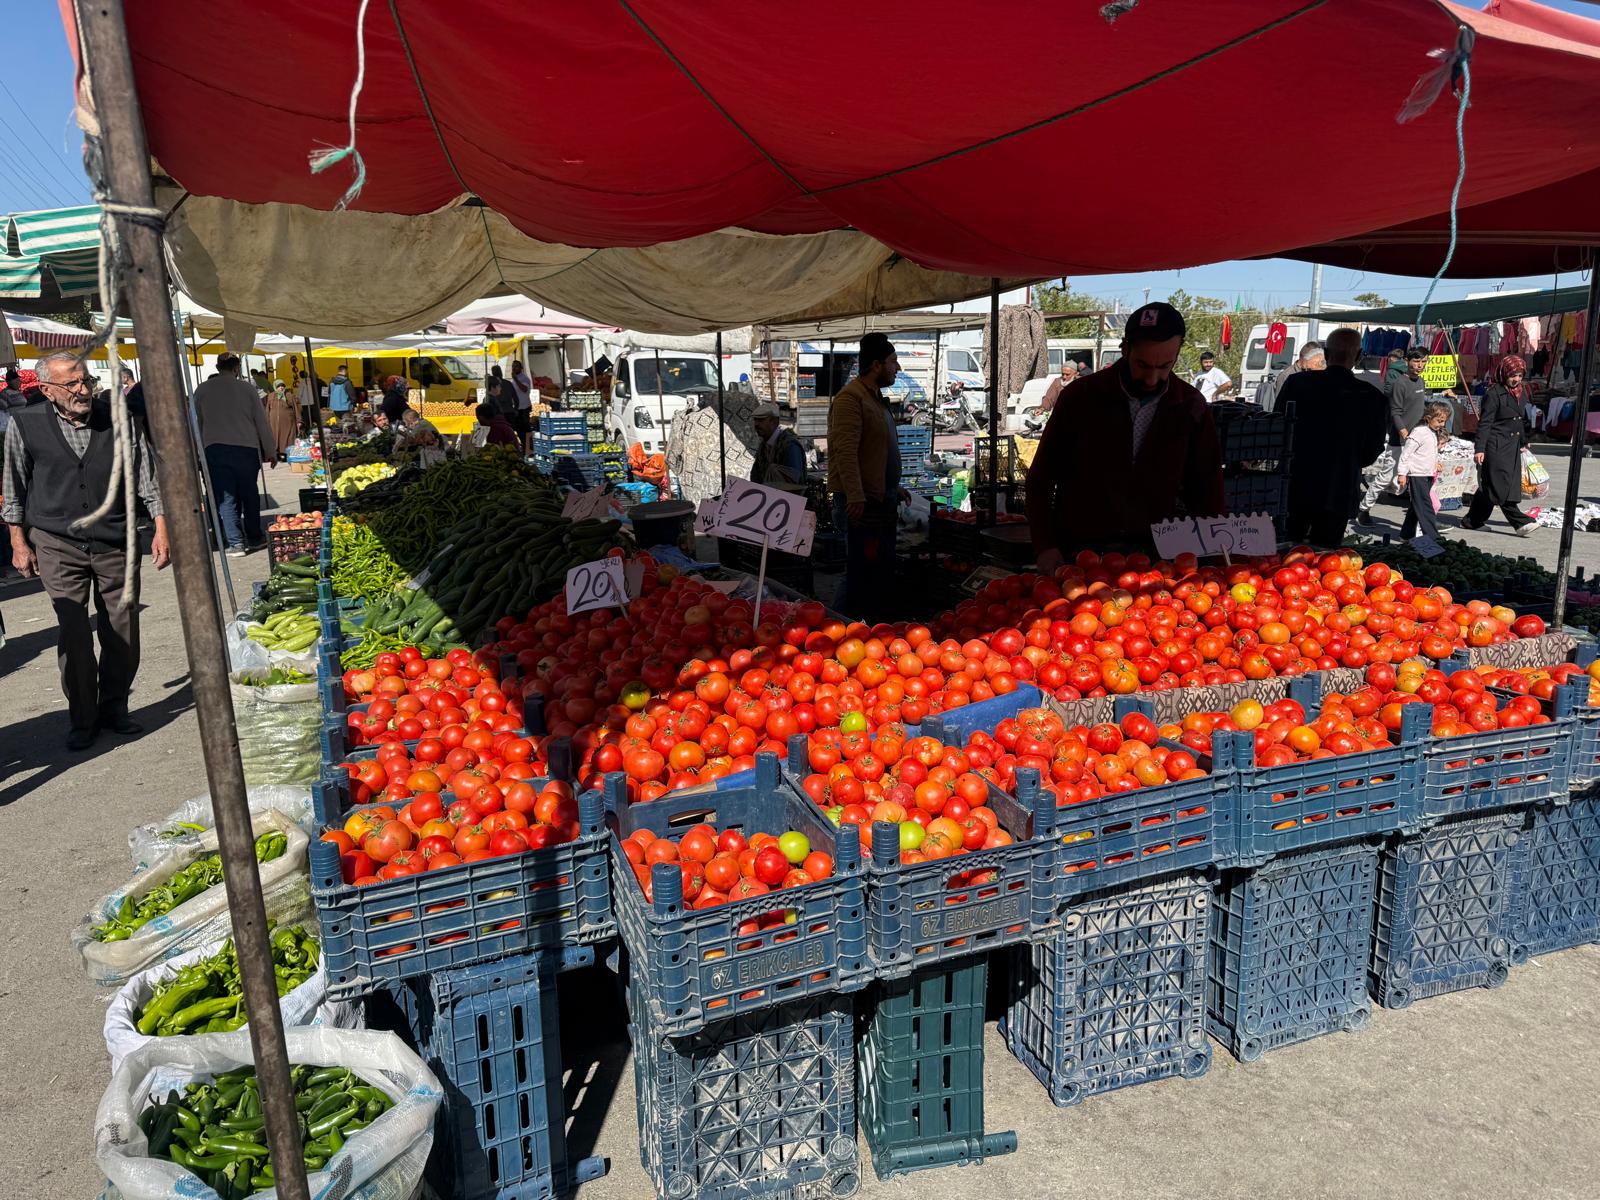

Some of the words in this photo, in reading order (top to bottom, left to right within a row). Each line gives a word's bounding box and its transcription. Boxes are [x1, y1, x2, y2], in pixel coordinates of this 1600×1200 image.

[1427, 356, 1448, 364] KUL
[726, 489, 790, 535] 20
[1192, 520, 1234, 555] 15
[572, 567, 611, 611] 20
[921, 915, 941, 937] ÖZ
[711, 966, 733, 990] ÖZ
